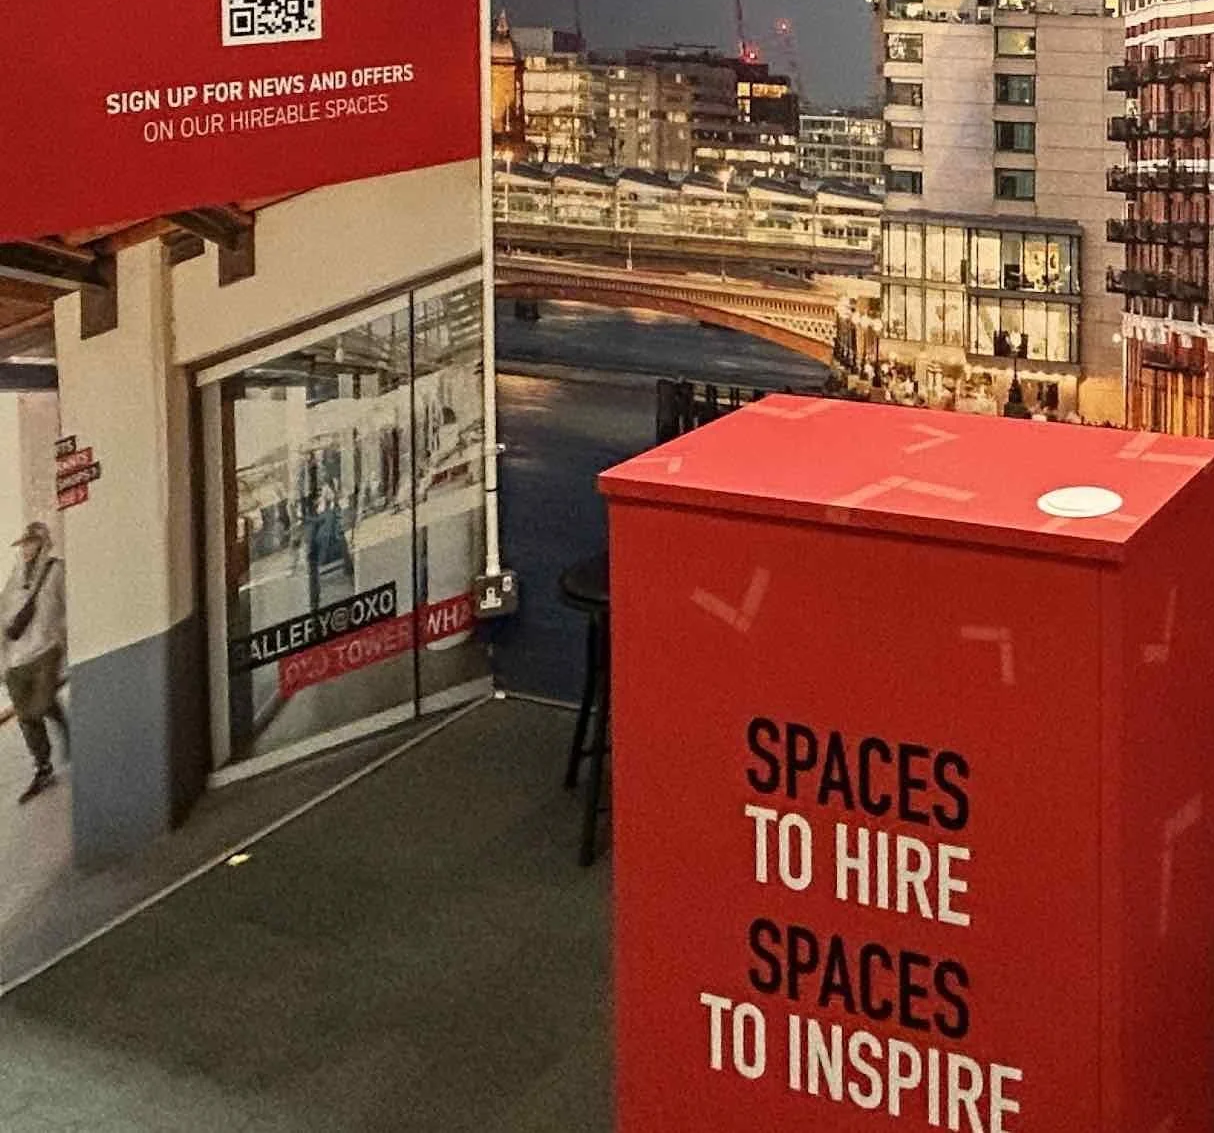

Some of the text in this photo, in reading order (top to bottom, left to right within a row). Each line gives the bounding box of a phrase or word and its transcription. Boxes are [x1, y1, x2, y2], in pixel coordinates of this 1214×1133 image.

[106, 63, 415, 115] SIGN UP FOR NEWS AND OFFERS
[143, 94, 390, 144] ON OUR HIREABLE SPACES
[745, 716, 970, 832] SPACES
[744, 803, 971, 927] TO HIRE
[748, 917, 970, 1040] SPACES
[699, 991, 1024, 1133] TO INSPIRE
